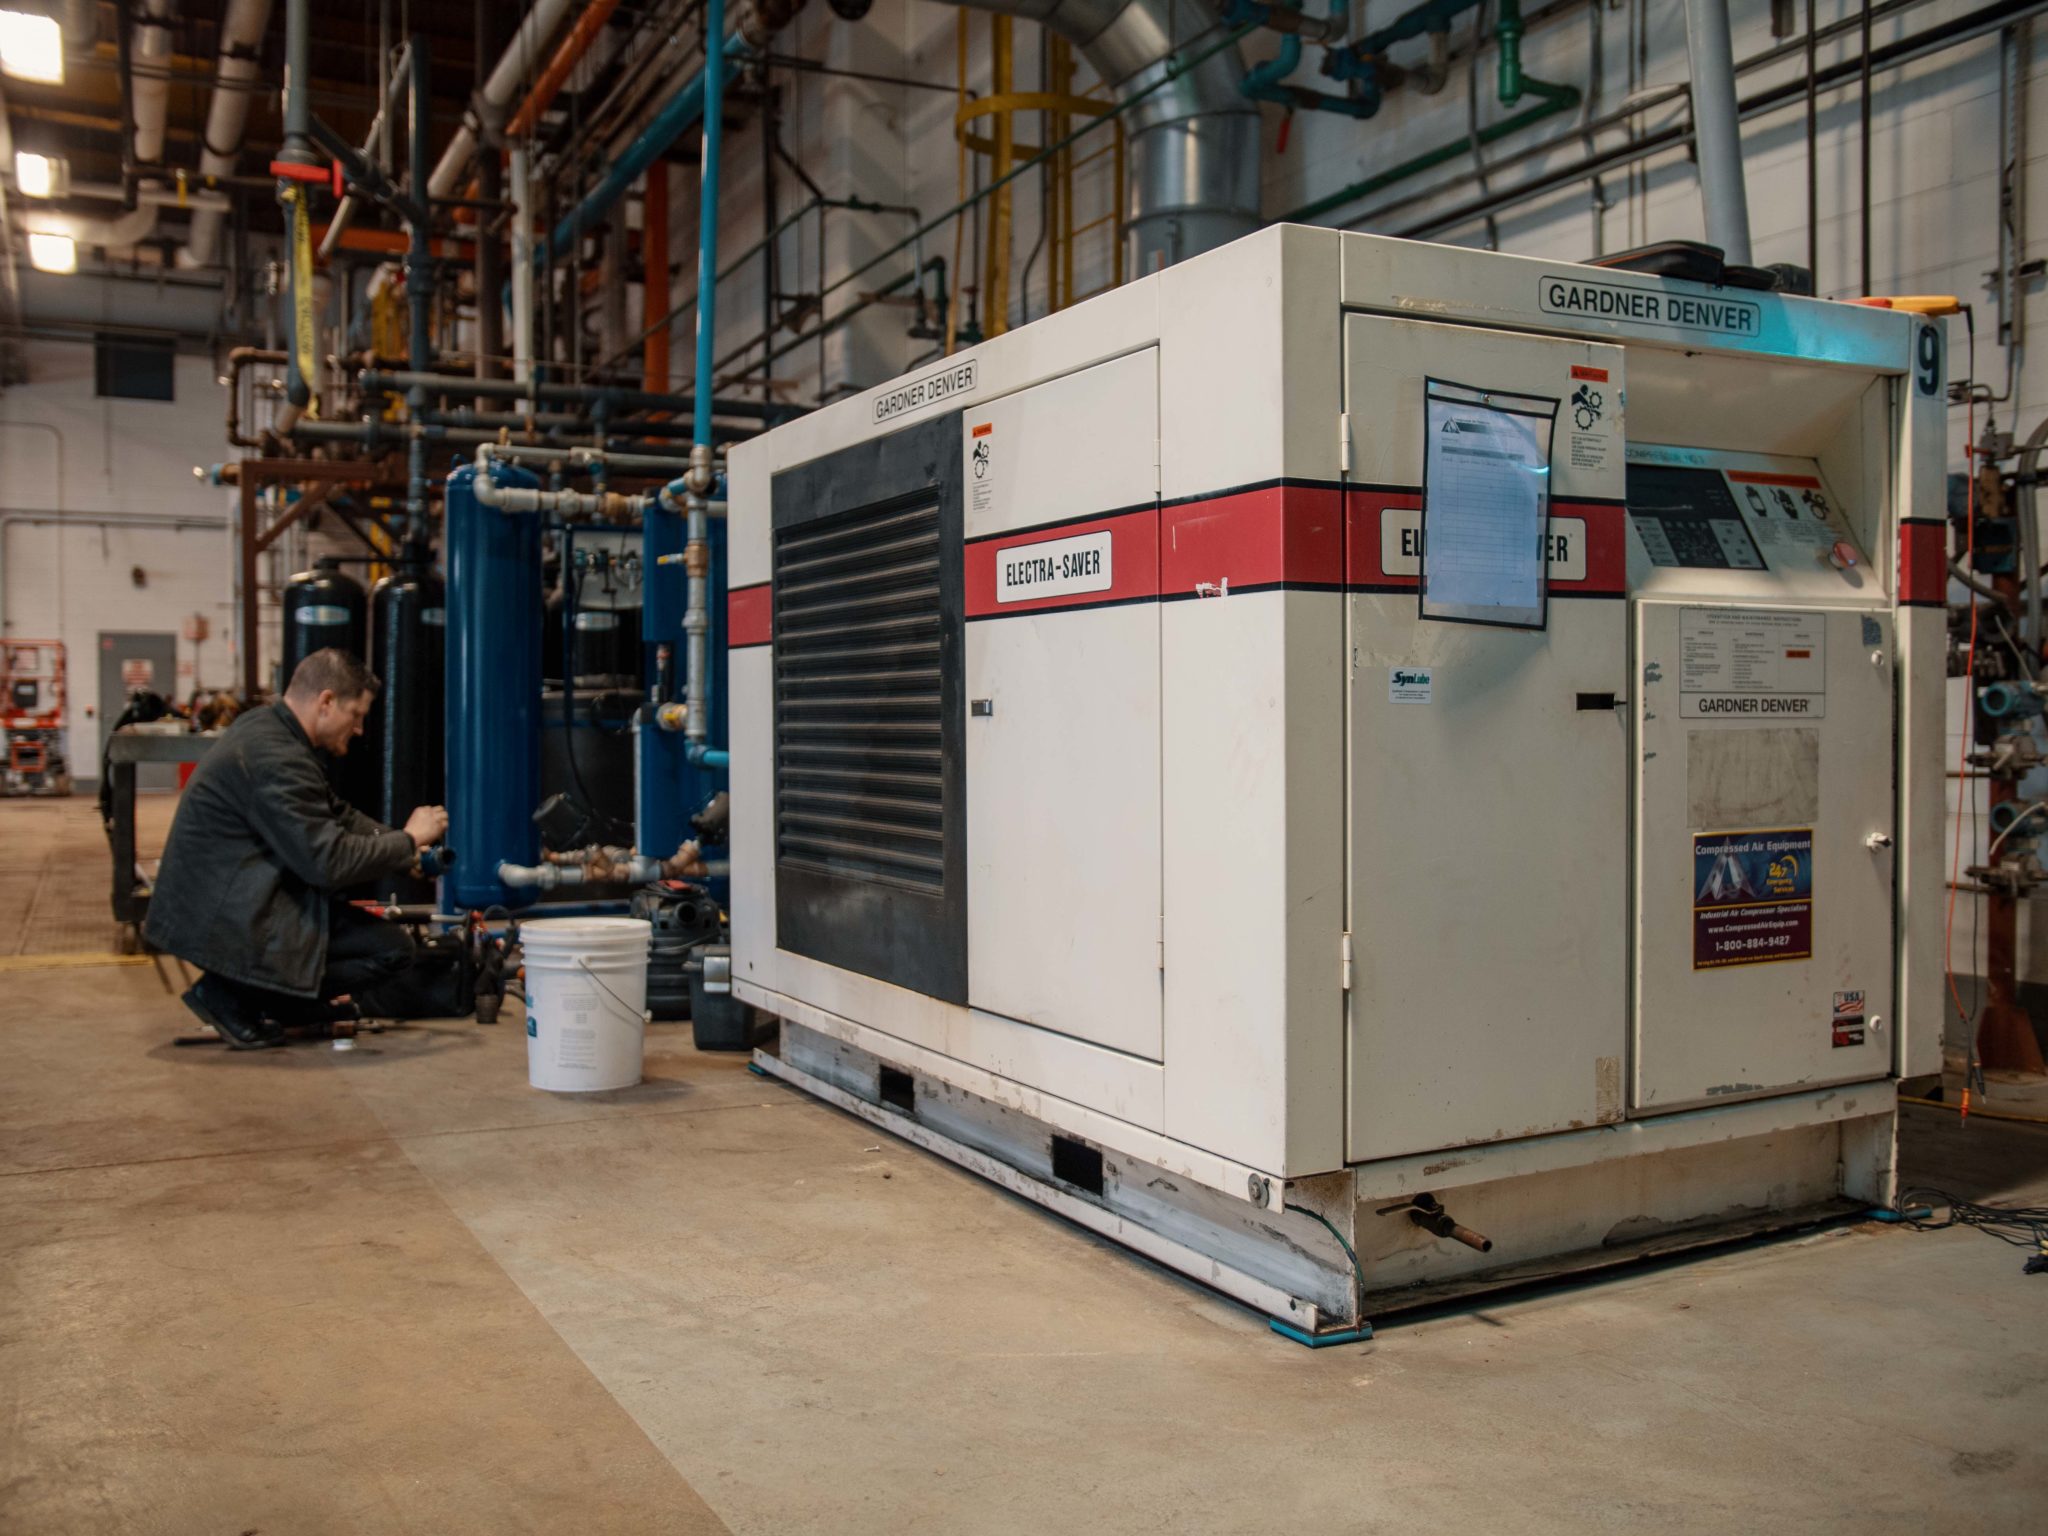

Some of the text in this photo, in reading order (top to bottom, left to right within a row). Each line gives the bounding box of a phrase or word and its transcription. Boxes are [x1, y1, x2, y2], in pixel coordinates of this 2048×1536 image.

[1549, 283, 1752, 331] GARDNER DENVER
[1918, 325, 1940, 395] 9
[876, 366, 973, 419] GARDNER DENVER
[1006, 549, 1101, 587] ELECTRA-SAVER
[1392, 670, 1430, 687] SynLube
[1698, 697, 1809, 713] GARDNER DENVER
[1695, 840, 1811, 856] Compressed Air Equipment
[1700, 910, 1730, 920] Industrial
[1730, 909, 1740, 918] Air
[1740, 907, 1776, 919] Compressor
[1707, 921, 1799, 934] www.CompressedAirEquip.com
[1715, 935, 1791, 951] 1-800-884-9427
[1844, 991, 1860, 1002] USA
